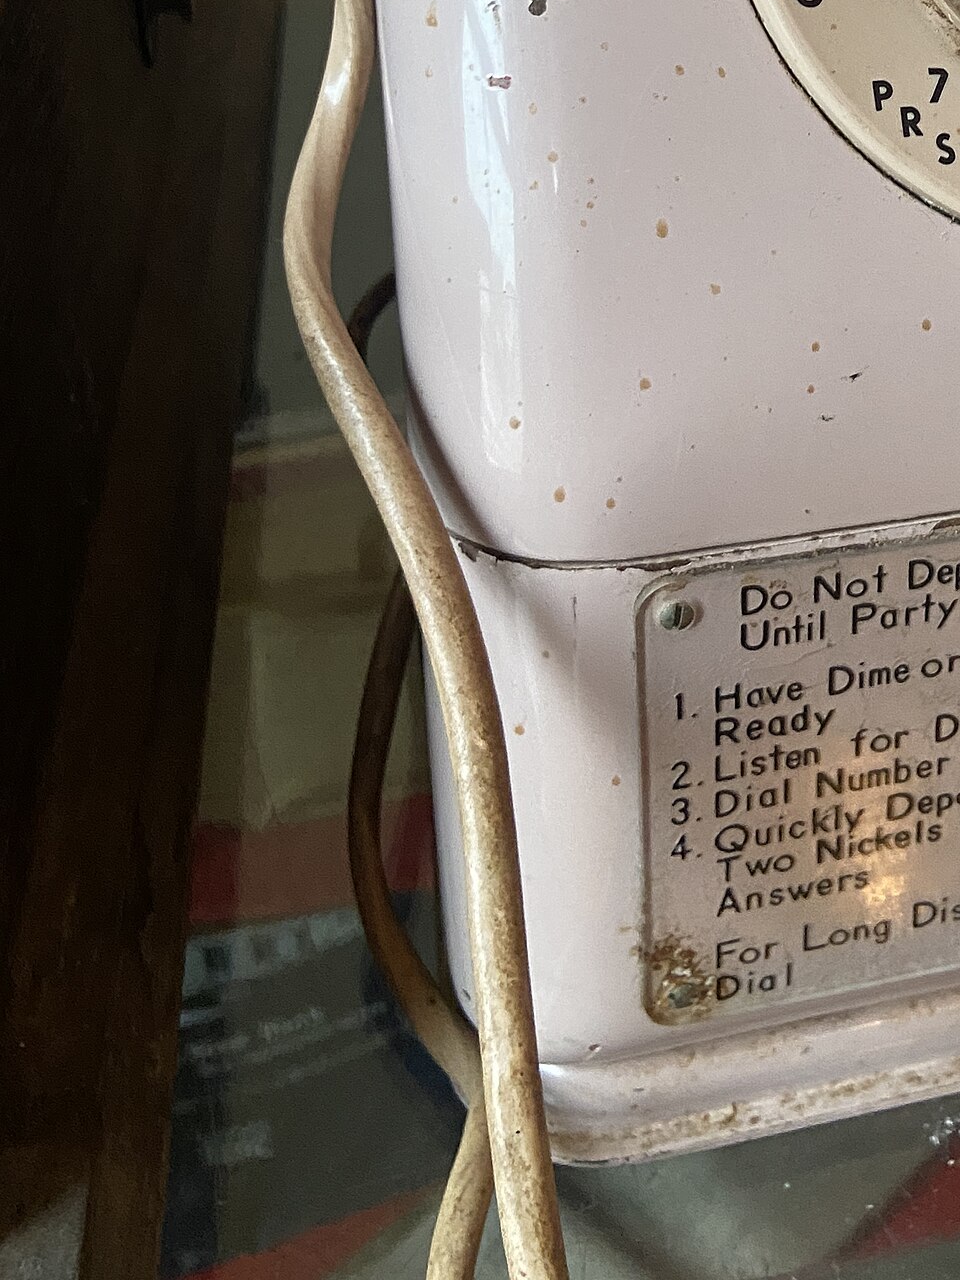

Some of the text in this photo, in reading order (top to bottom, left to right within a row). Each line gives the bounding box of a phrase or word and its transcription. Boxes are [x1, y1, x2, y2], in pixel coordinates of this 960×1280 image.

[928, 67, 949, 103] 7
[741, 585, 793, 616] Do
[813, 565, 887, 603] Not
[741, 610, 825, 651] Until
[851, 593, 959, 635] Party
[674, 693, 699, 720] 1.
[715, 681, 804, 714] Have
[828, 661, 910, 696] Dime
[715, 704, 836, 746] Ready
[671, 761, 704, 791] 2.
[715, 745, 821, 782] Listen
[850, 728, 909, 756] for
[671, 797, 704, 825] 3.
[715, 778, 790, 819] Dial
[816, 756, 950, 798] Number
[670, 834, 704, 860] 4.
[715, 804, 865, 853] Quickly
[716, 853, 795, 882] Two
[816, 820, 943, 864] Nickels
[716, 869, 870, 917] Answers
[716, 938, 780, 969] For
[803, 919, 892, 951] Long
[716, 962, 793, 1001] Dial
